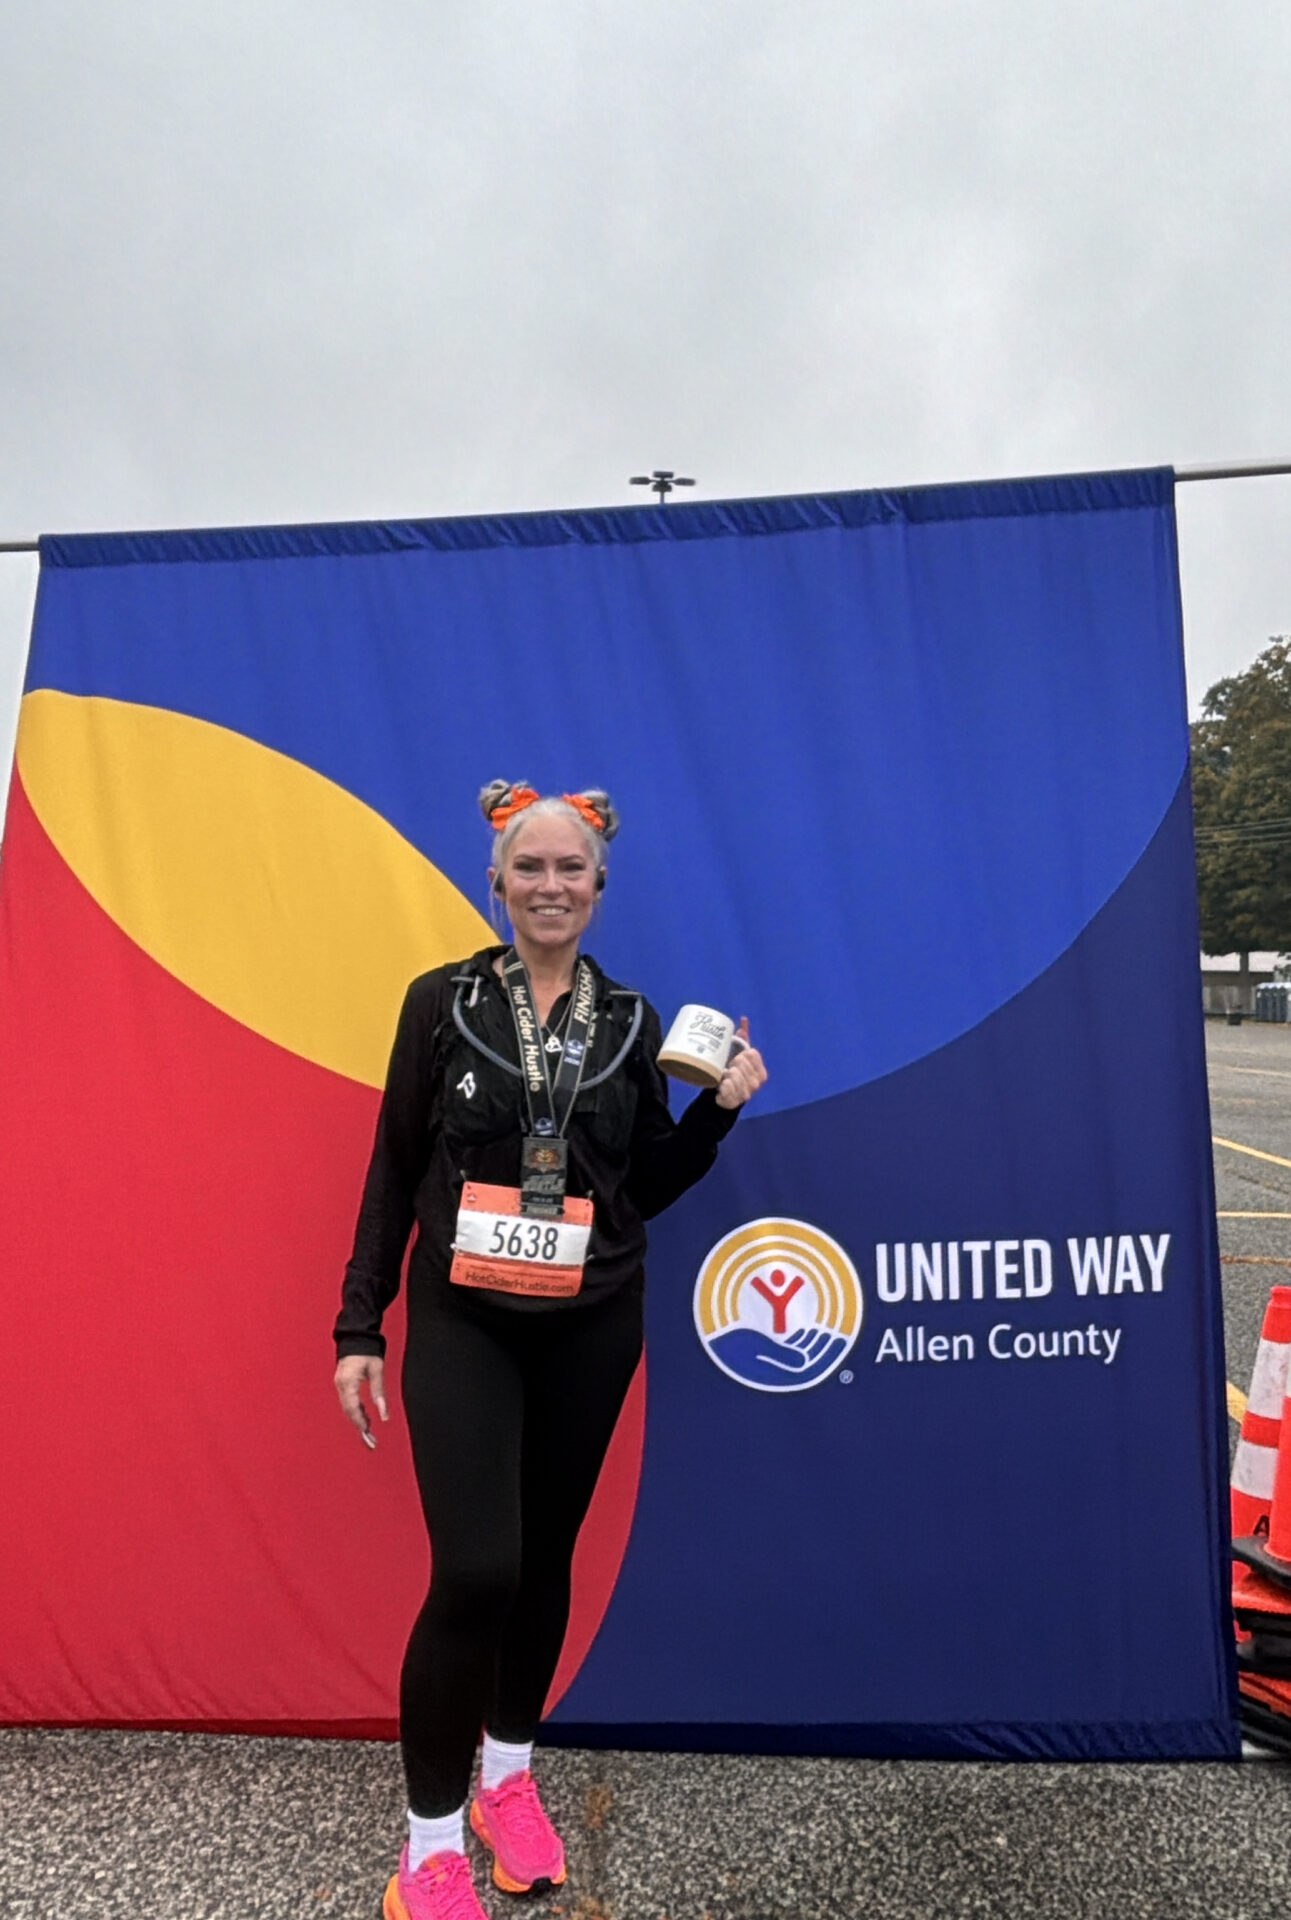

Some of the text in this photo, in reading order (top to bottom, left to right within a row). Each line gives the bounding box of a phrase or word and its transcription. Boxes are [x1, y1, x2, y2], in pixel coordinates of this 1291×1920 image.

[511, 985, 545, 1093] Hot Cider Hustle
[489, 1221, 559, 1261] 5638
[876, 1233, 1171, 1302] UNITED WAY
[875, 1324, 1122, 1365] Allen County
